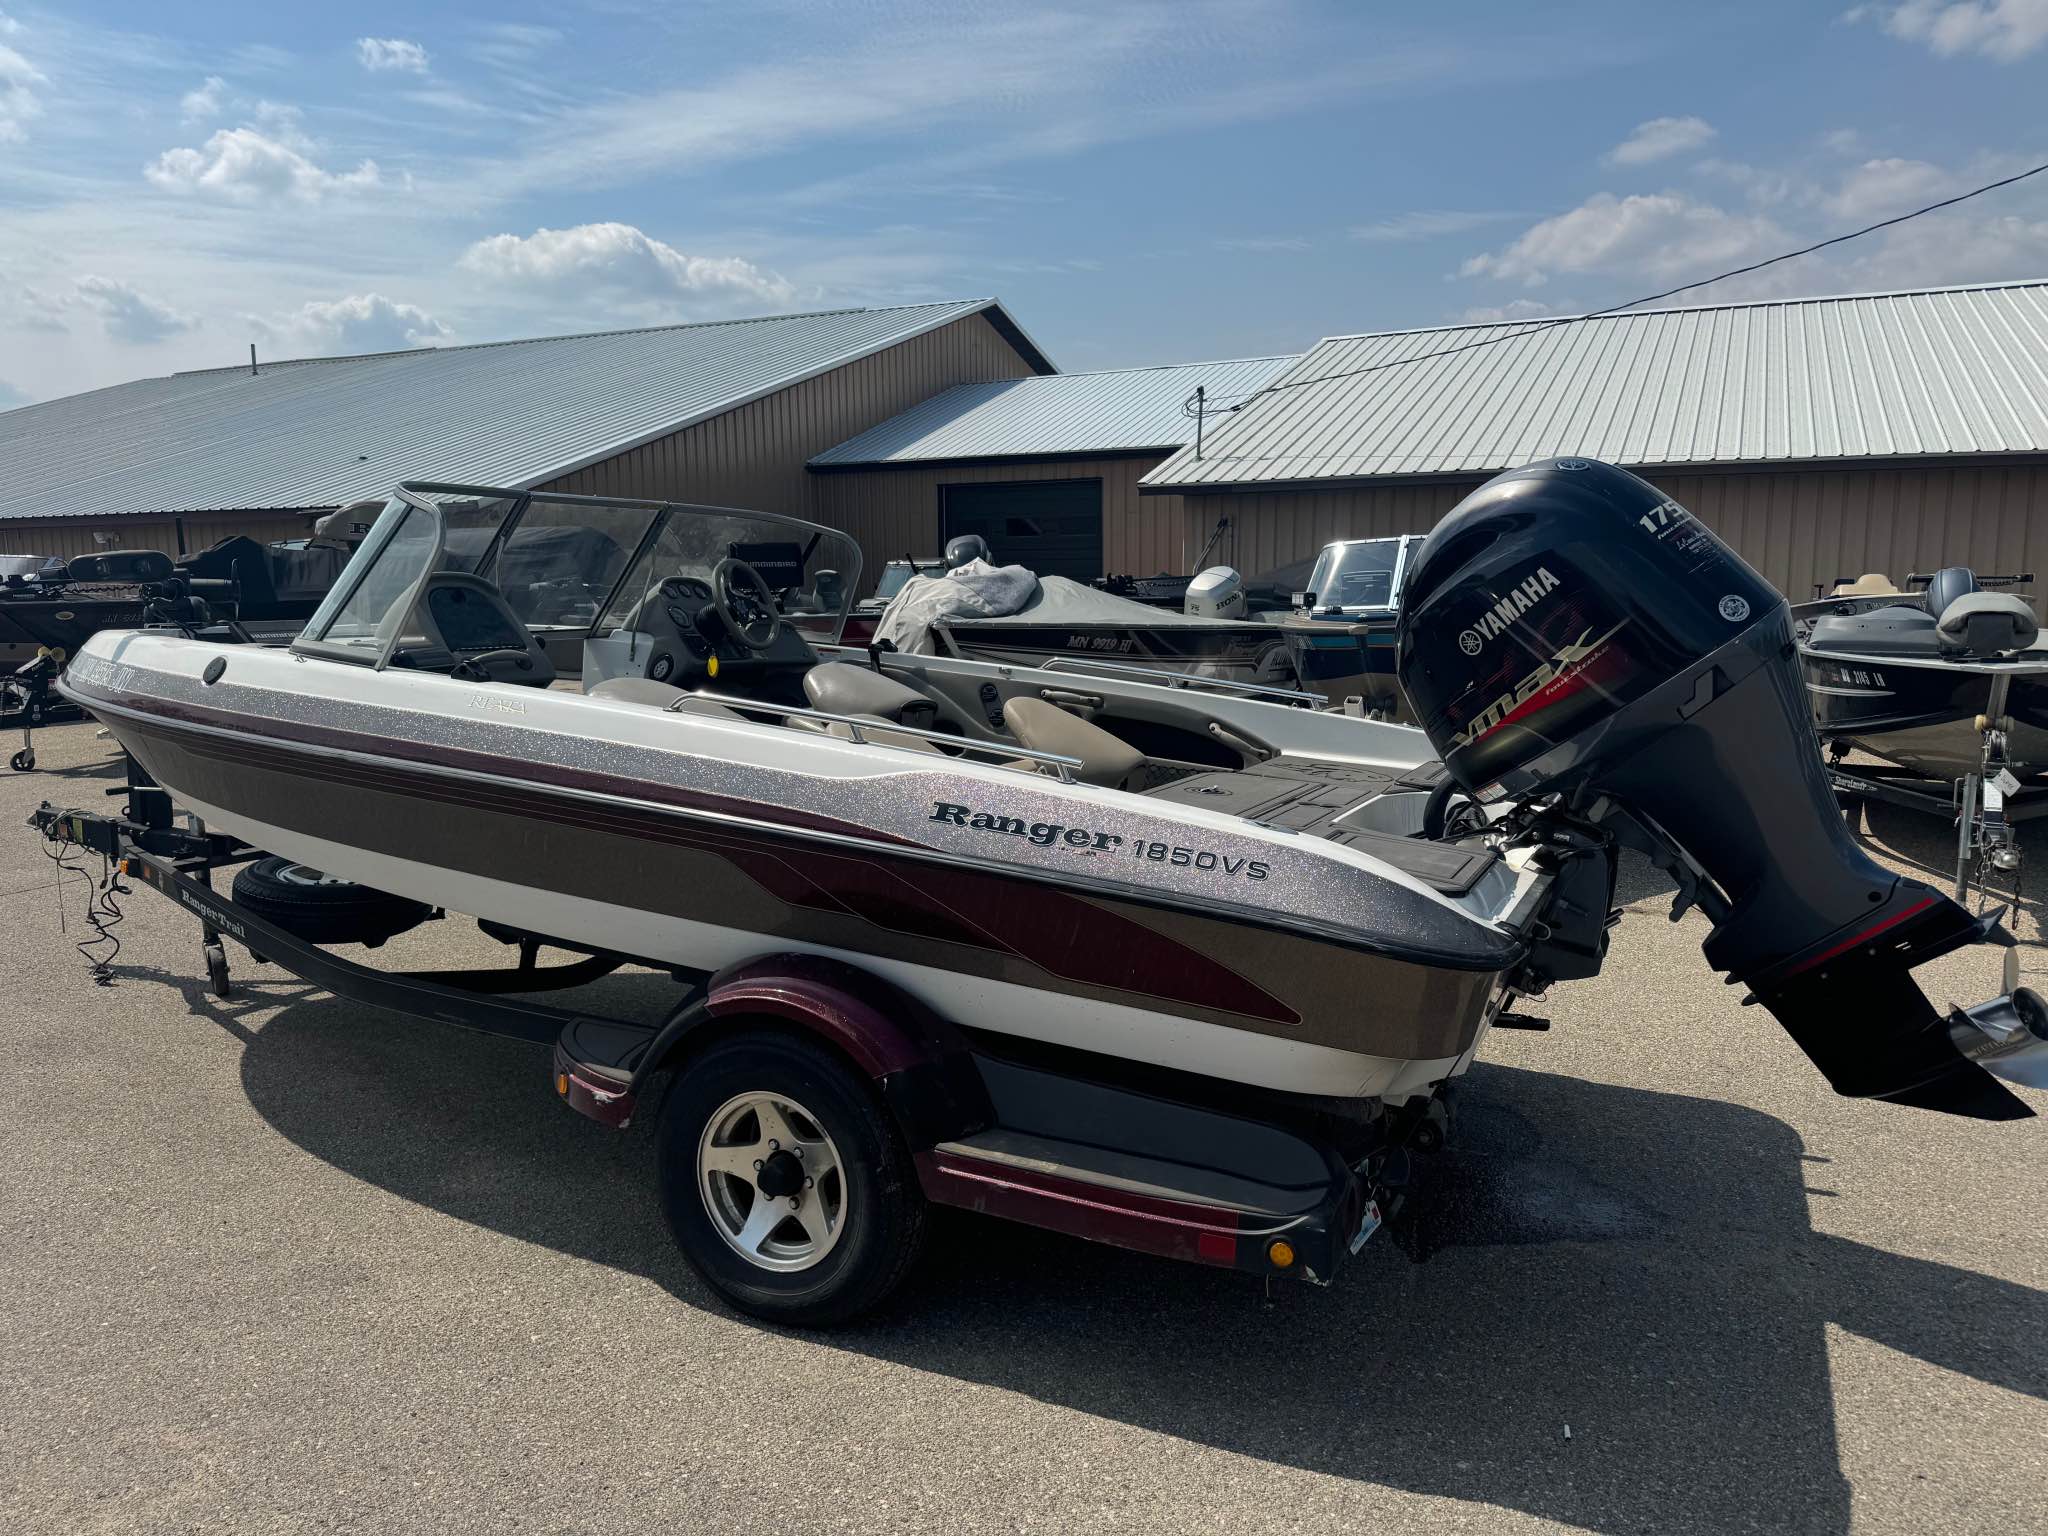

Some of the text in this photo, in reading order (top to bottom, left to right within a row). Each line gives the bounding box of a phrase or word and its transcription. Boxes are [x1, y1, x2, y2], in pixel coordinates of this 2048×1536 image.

[1640, 501, 1684, 533] 175
[1474, 567, 1560, 642] YAMAHA
[1545, 645, 1609, 697] fourstroke
[928, 801, 1271, 881] Ranger 1850VS
